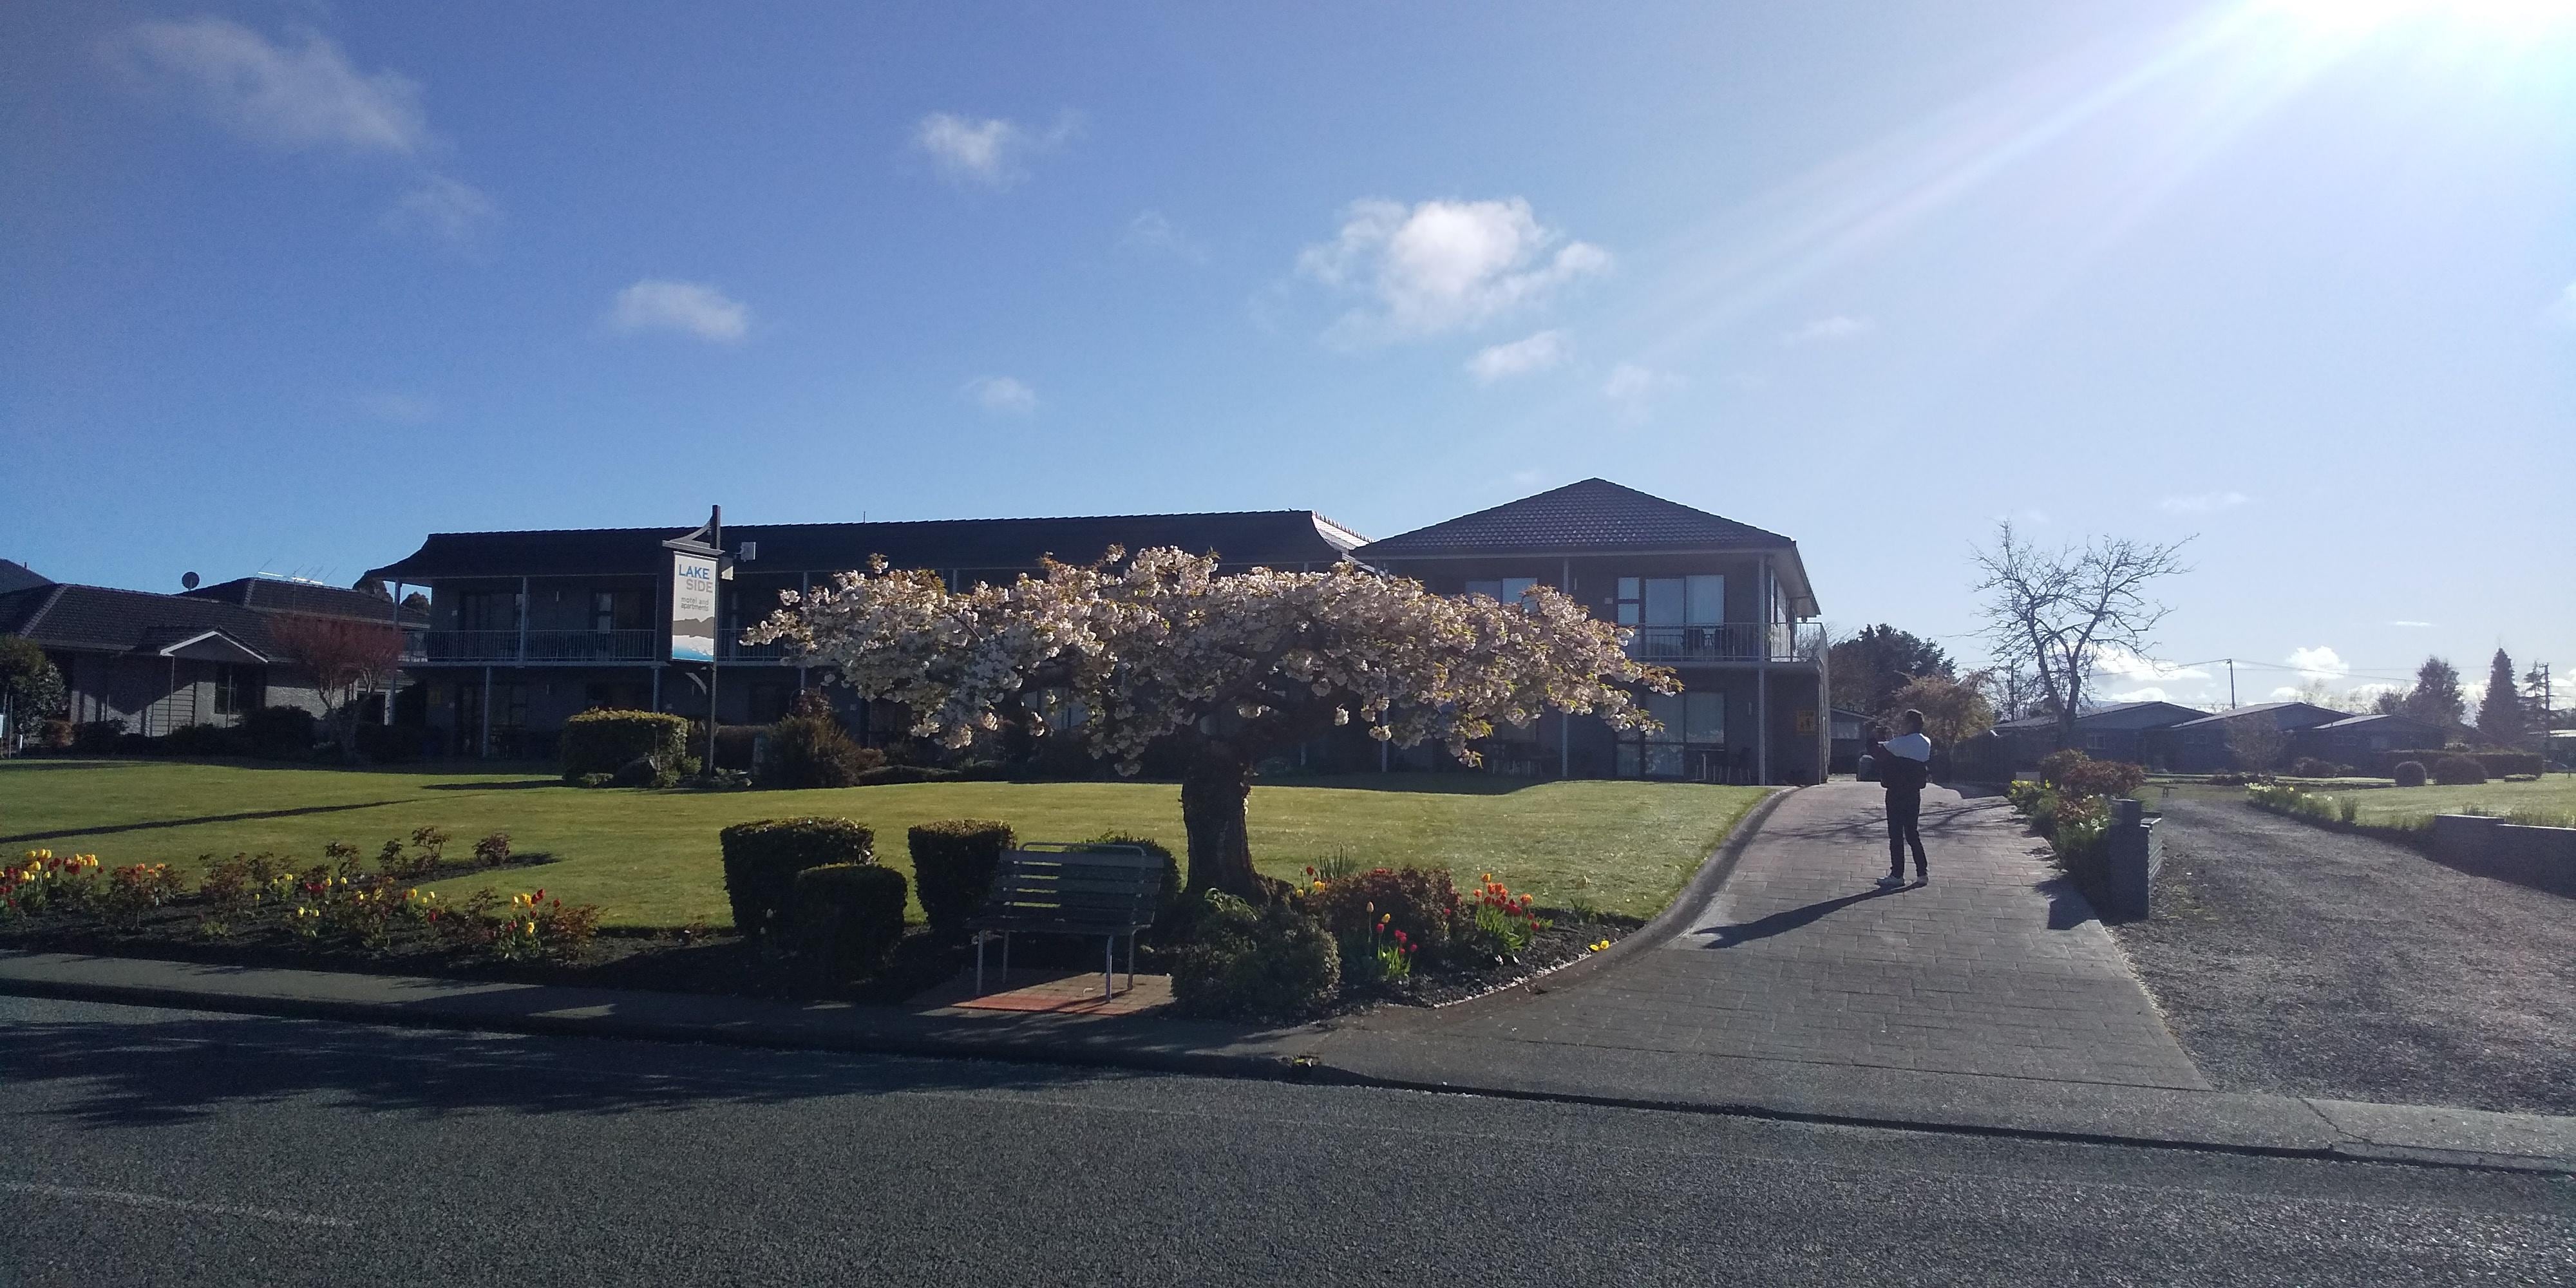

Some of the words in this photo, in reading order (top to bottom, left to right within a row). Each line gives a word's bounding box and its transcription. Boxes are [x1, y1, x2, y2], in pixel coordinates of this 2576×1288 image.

[679, 564, 710, 579] LAKE
[687, 579, 713, 592] SIDE
[681, 603, 709, 611] apartments
